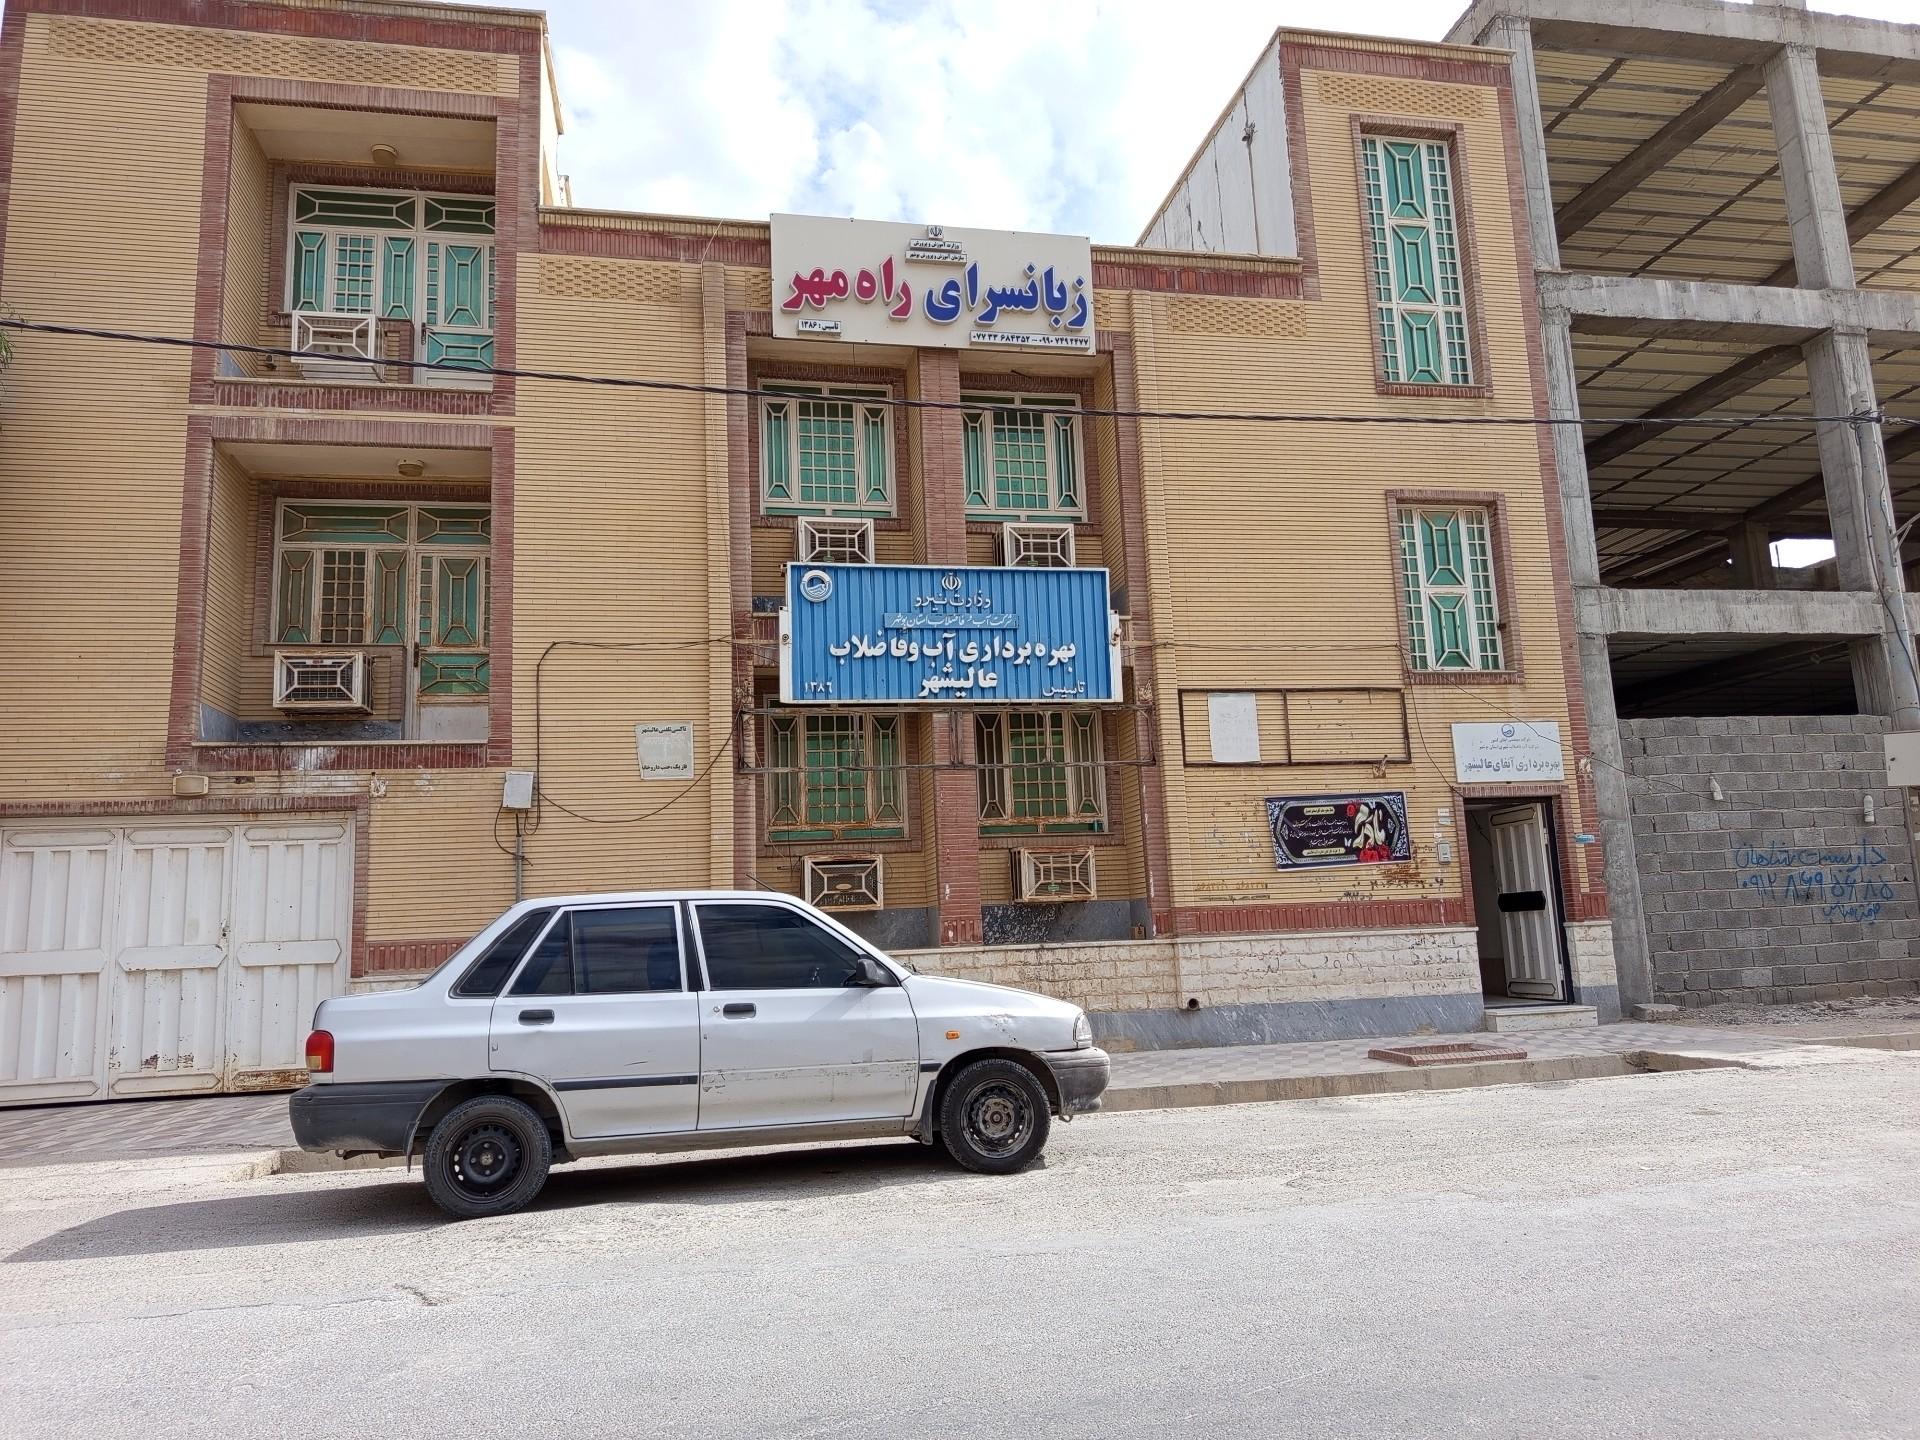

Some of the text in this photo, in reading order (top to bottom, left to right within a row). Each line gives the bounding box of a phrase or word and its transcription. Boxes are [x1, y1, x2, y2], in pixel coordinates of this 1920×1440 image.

[780, 254, 1089, 328] زبانسرای راه مهر
[801, 320, 817, 329] ۱۳۸۶
[914, 590, 991, 611] وزارت نیرو
[890, 612, 908, 629] بوشهر
[906, 614, 928, 626] استان
[928, 613, 965, 628] فاضلاب
[972, 615, 991, 627] آب
[990, 613, 1013, 627] شرکت
[922, 632, 957, 668] آب
[958, 635, 1033, 666] برداری
[1034, 641, 1076, 673] بهره
[918, 661, 998, 698] عالیشهر
[1042, 679, 1086, 698] تاسیس
[659, 726, 671, 734] تلفنی
[1463, 757, 1493, 773] عالیشهر
[1515, 759, 1545, 773] برداری
[1545, 759, 1560, 774] بهره
